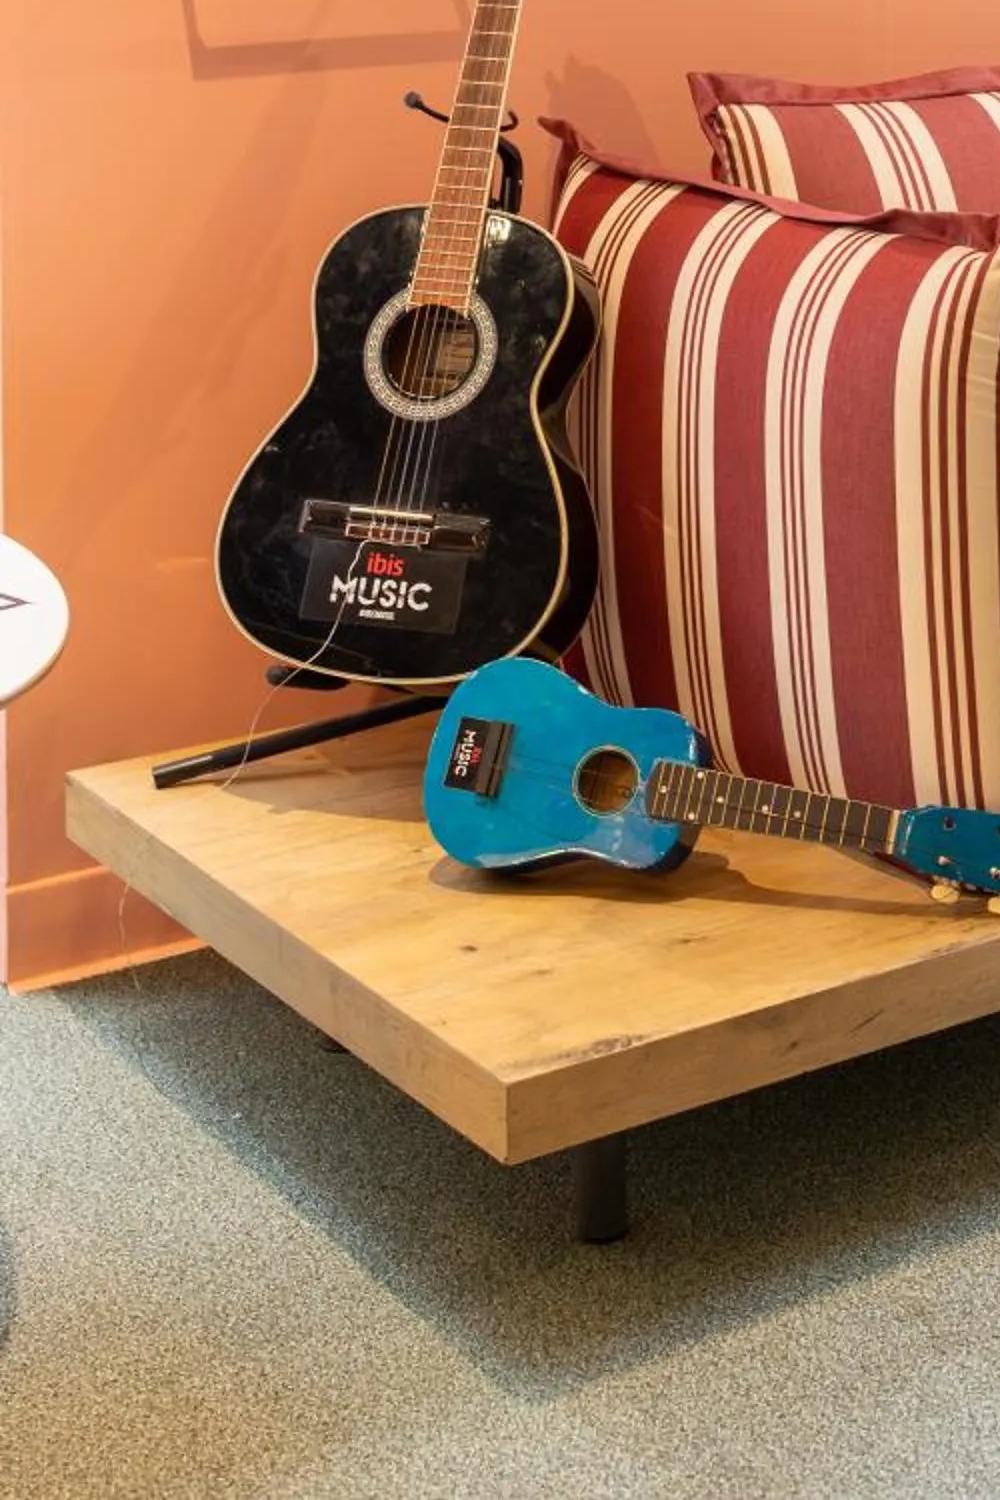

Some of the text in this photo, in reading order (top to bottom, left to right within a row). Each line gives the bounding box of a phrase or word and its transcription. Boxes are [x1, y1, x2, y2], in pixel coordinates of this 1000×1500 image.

[366, 552, 406, 577] ibis
[329, 574, 433, 612] MUSIC
[455, 729, 477, 777] MUSIC
